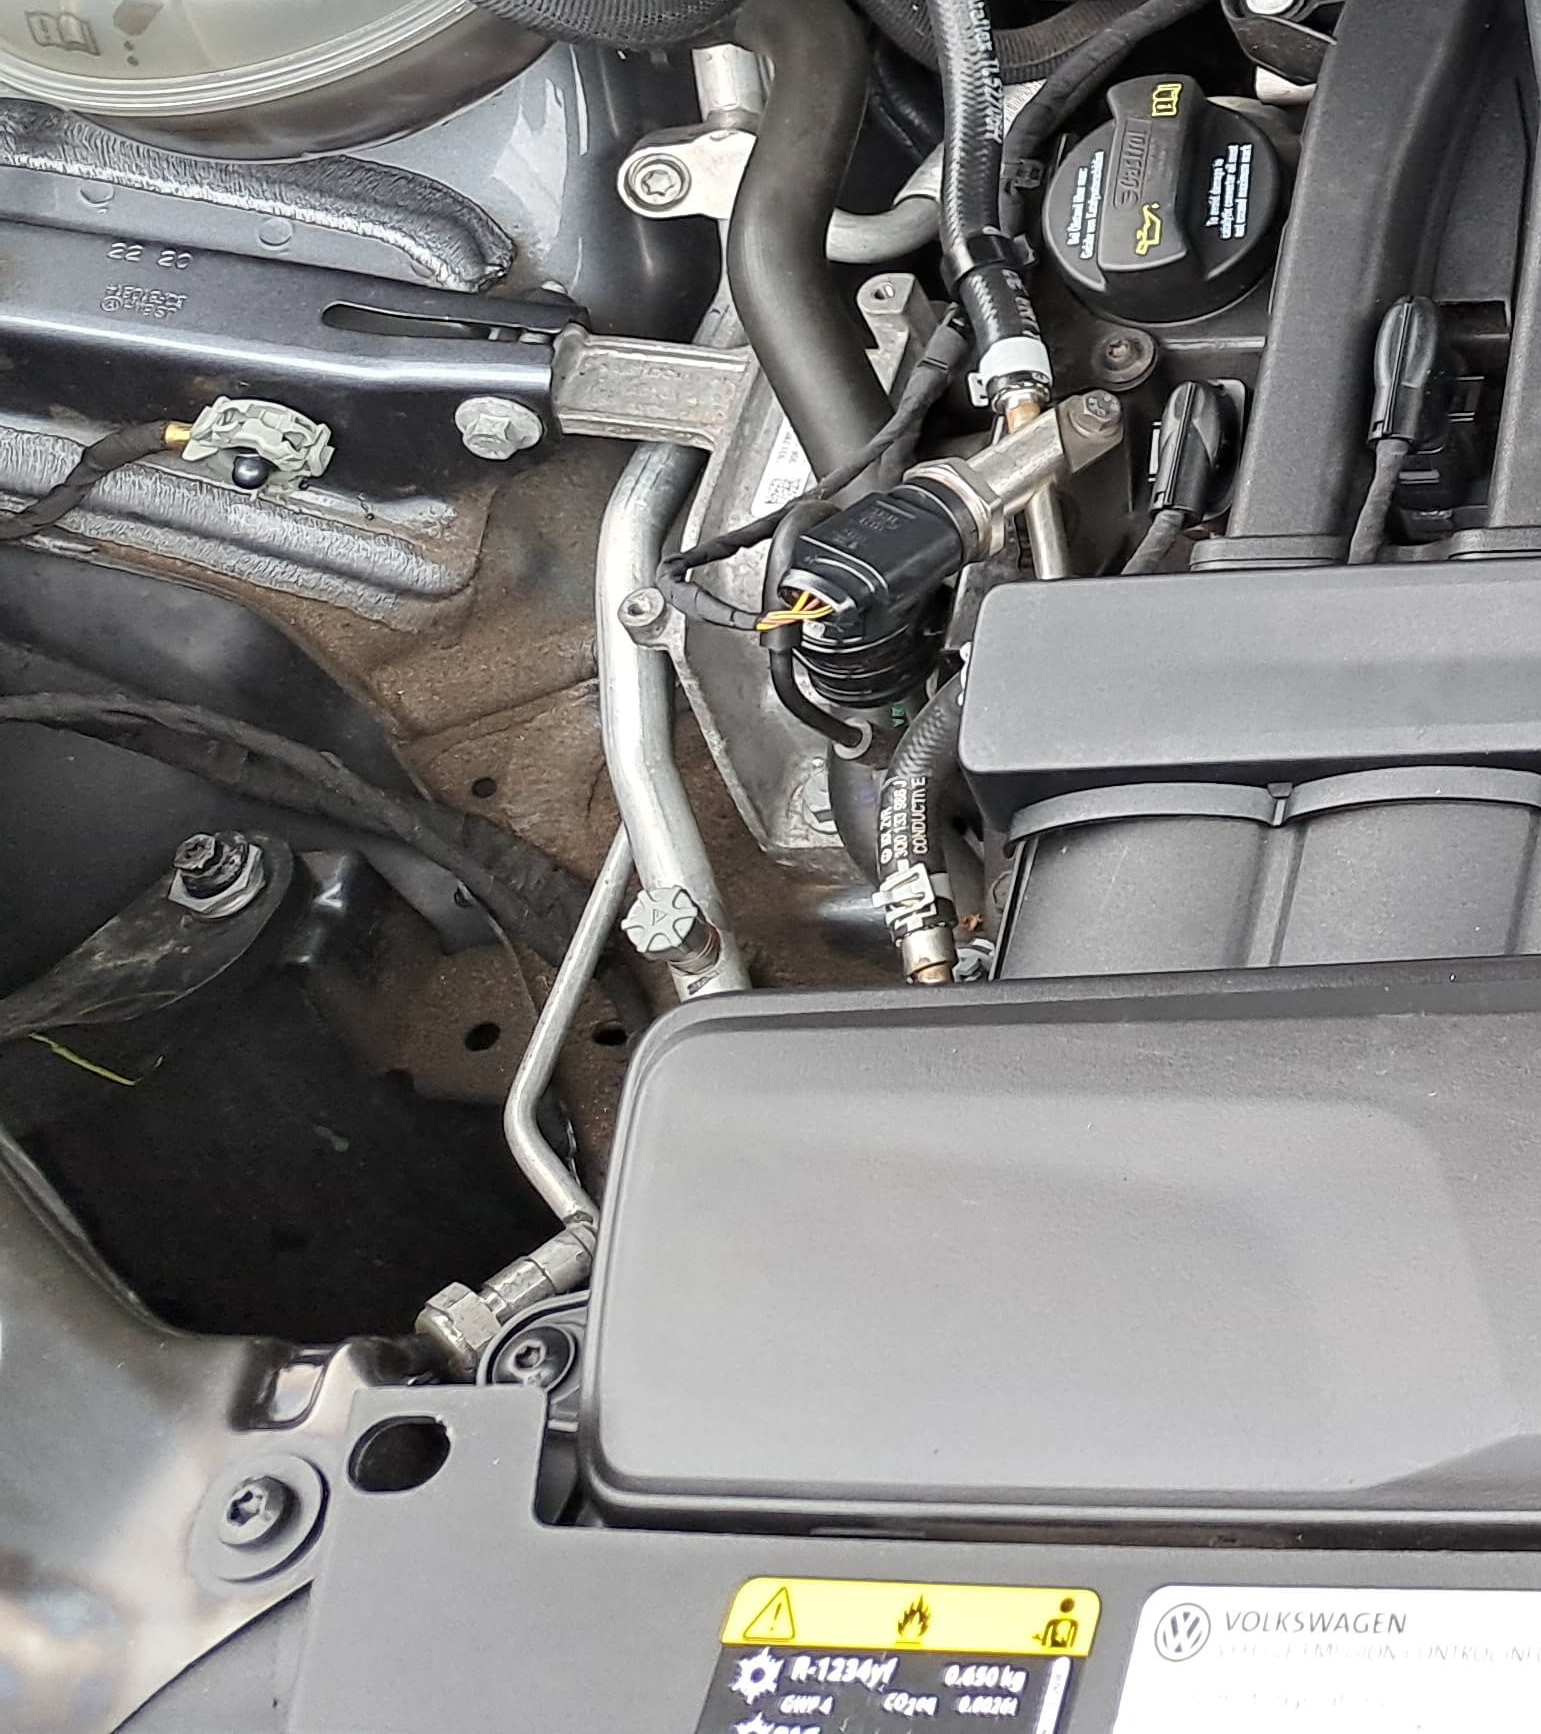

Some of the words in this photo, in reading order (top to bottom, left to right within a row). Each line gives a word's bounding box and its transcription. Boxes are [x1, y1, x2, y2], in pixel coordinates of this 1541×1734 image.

[106, 242, 145, 262] 22
[911, 776, 928, 855] CONDUCTIVE
[1225, 1611, 1407, 1634] VOLKSWAGEN
[1000, 1665, 1027, 1693] kg
